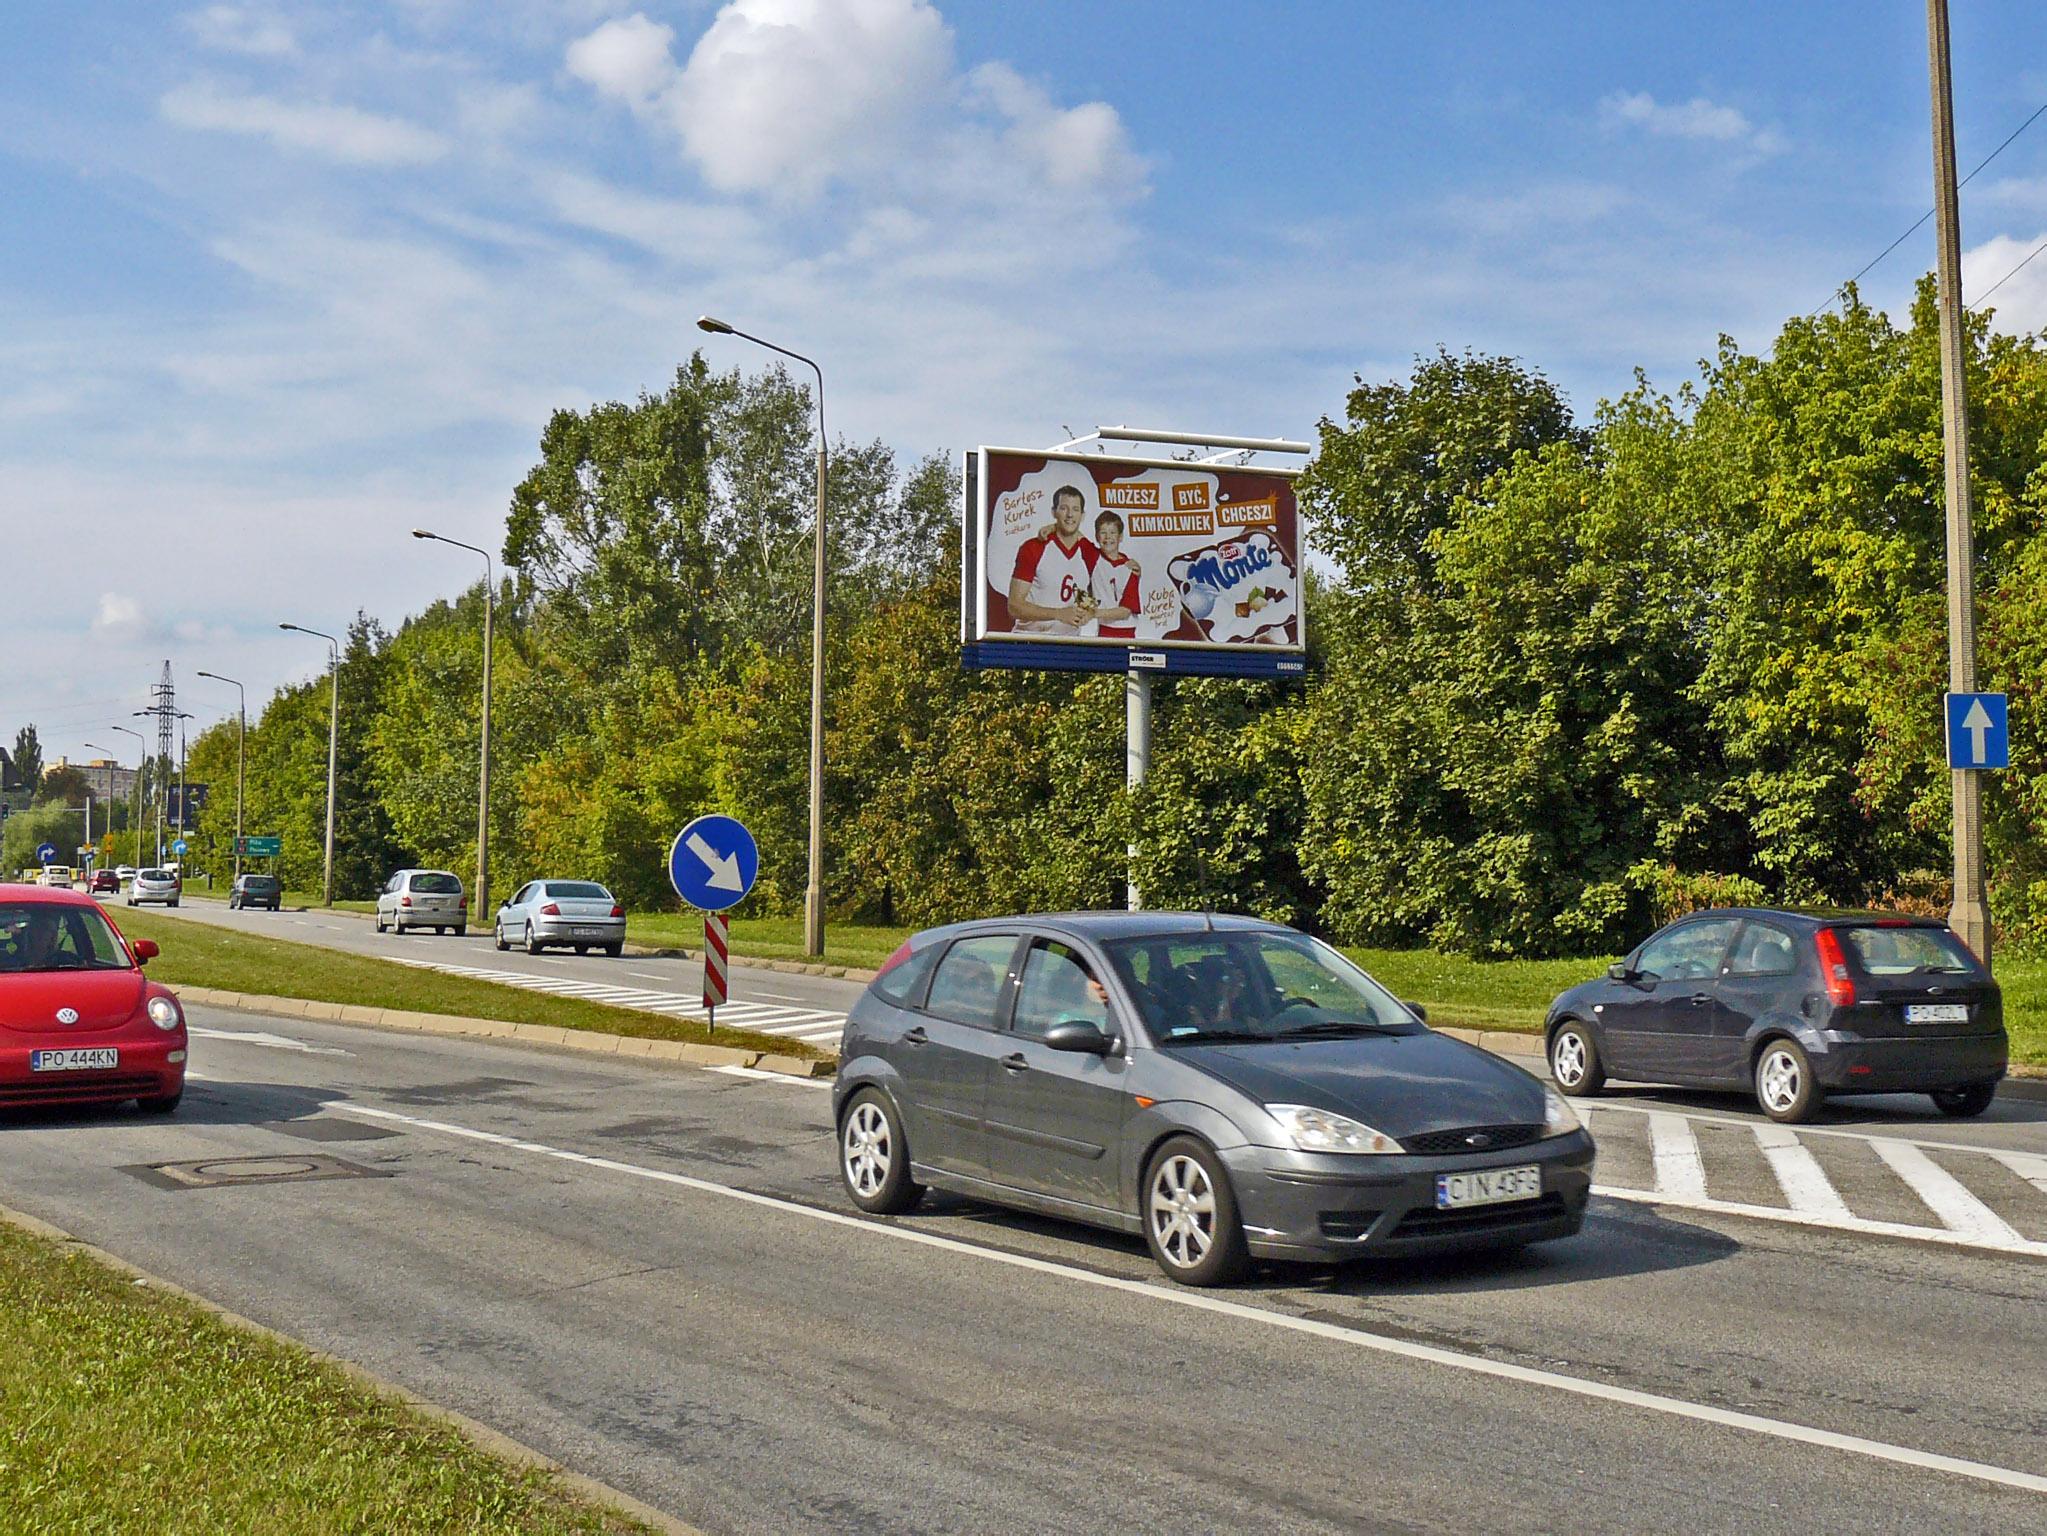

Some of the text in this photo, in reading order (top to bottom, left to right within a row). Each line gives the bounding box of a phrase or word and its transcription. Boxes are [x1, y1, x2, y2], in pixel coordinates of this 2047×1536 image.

[1003, 490, 1044, 511] Bartosz
[1105, 484, 1157, 504] MOŻESZ
[1004, 504, 1036, 525] Kurek
[1132, 516, 1212, 532] KIMKOLWIEK
[1187, 544, 1272, 592] Monte
[1060, 574, 1074, 602] 6
[1109, 577, 1118, 602] 1
[1143, 601, 1175, 615] Kurek
[42, 1050, 115, 1067] PO 444KN
[1450, 1173, 1491, 1200] CIN
